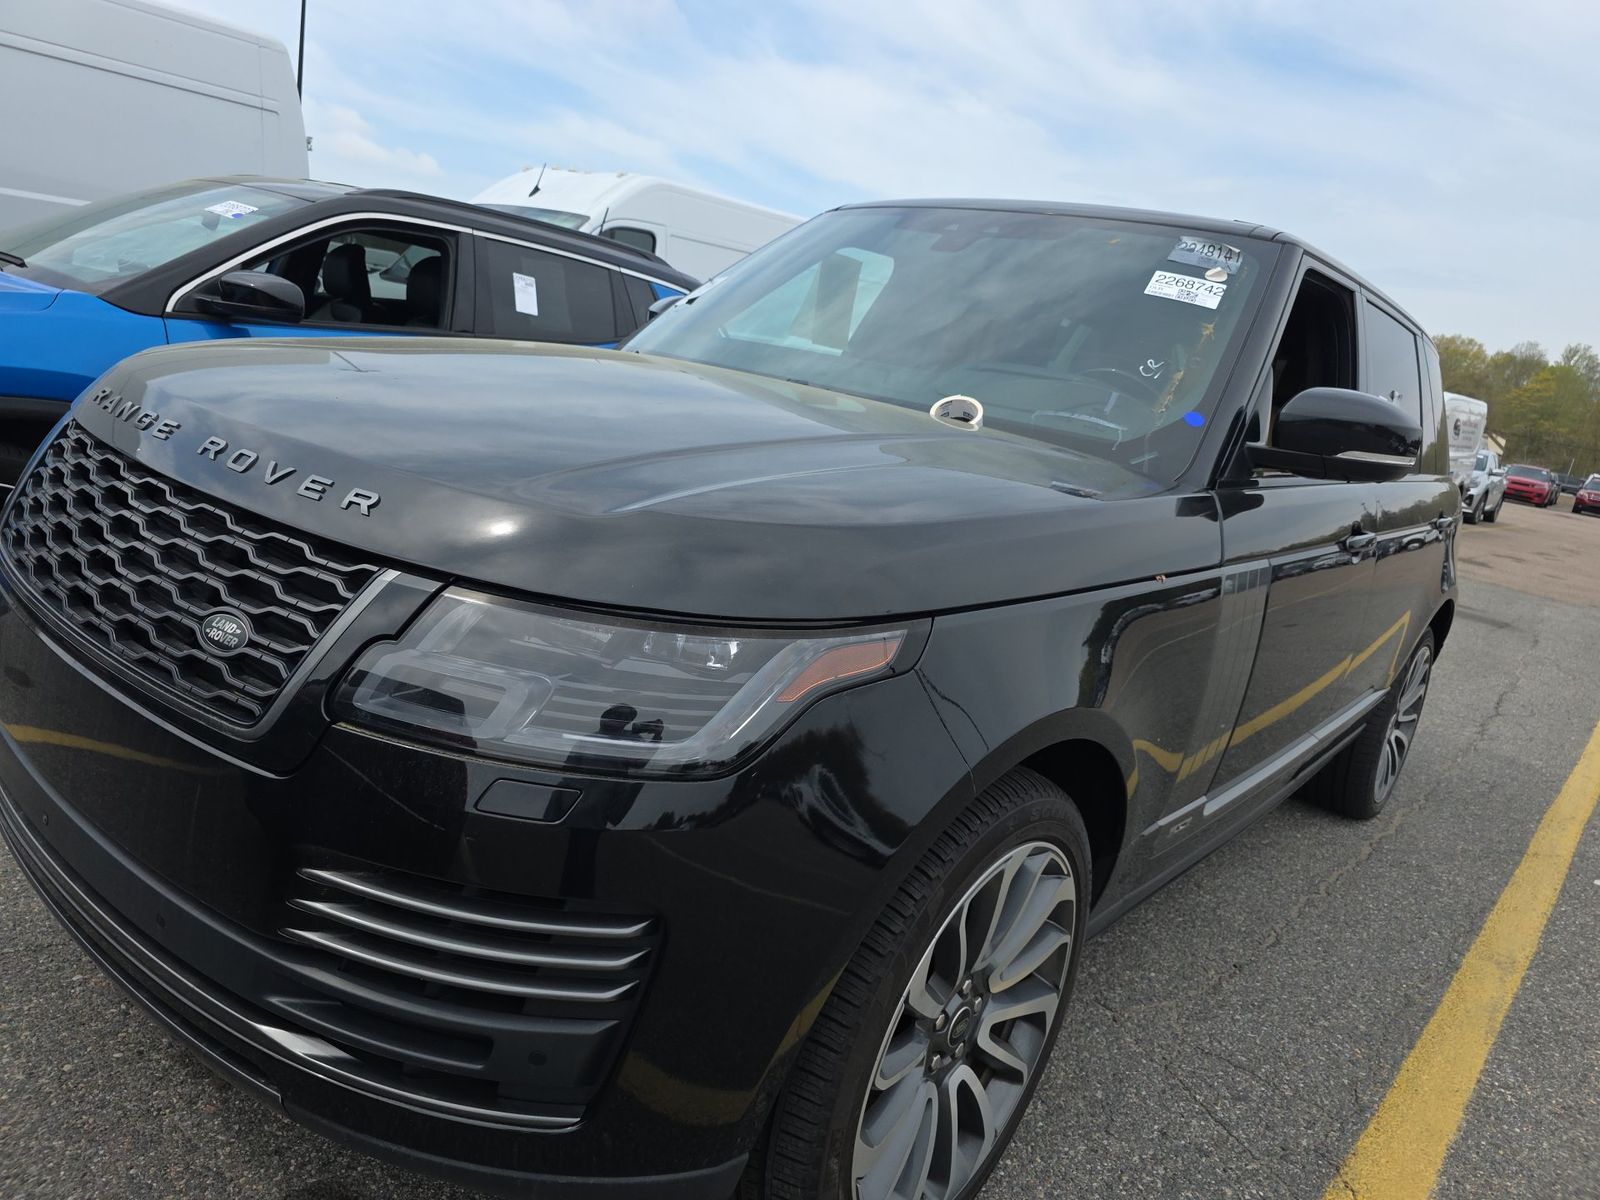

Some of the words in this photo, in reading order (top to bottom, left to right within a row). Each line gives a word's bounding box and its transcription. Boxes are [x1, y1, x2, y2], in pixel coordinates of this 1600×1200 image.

[1155, 274, 1225, 297] 2268742
[93, 386, 181, 440] RANGE
[196, 435, 381, 516] ROVER
[211, 616, 238, 634] LAND
[208, 628, 239, 648] ROVER
